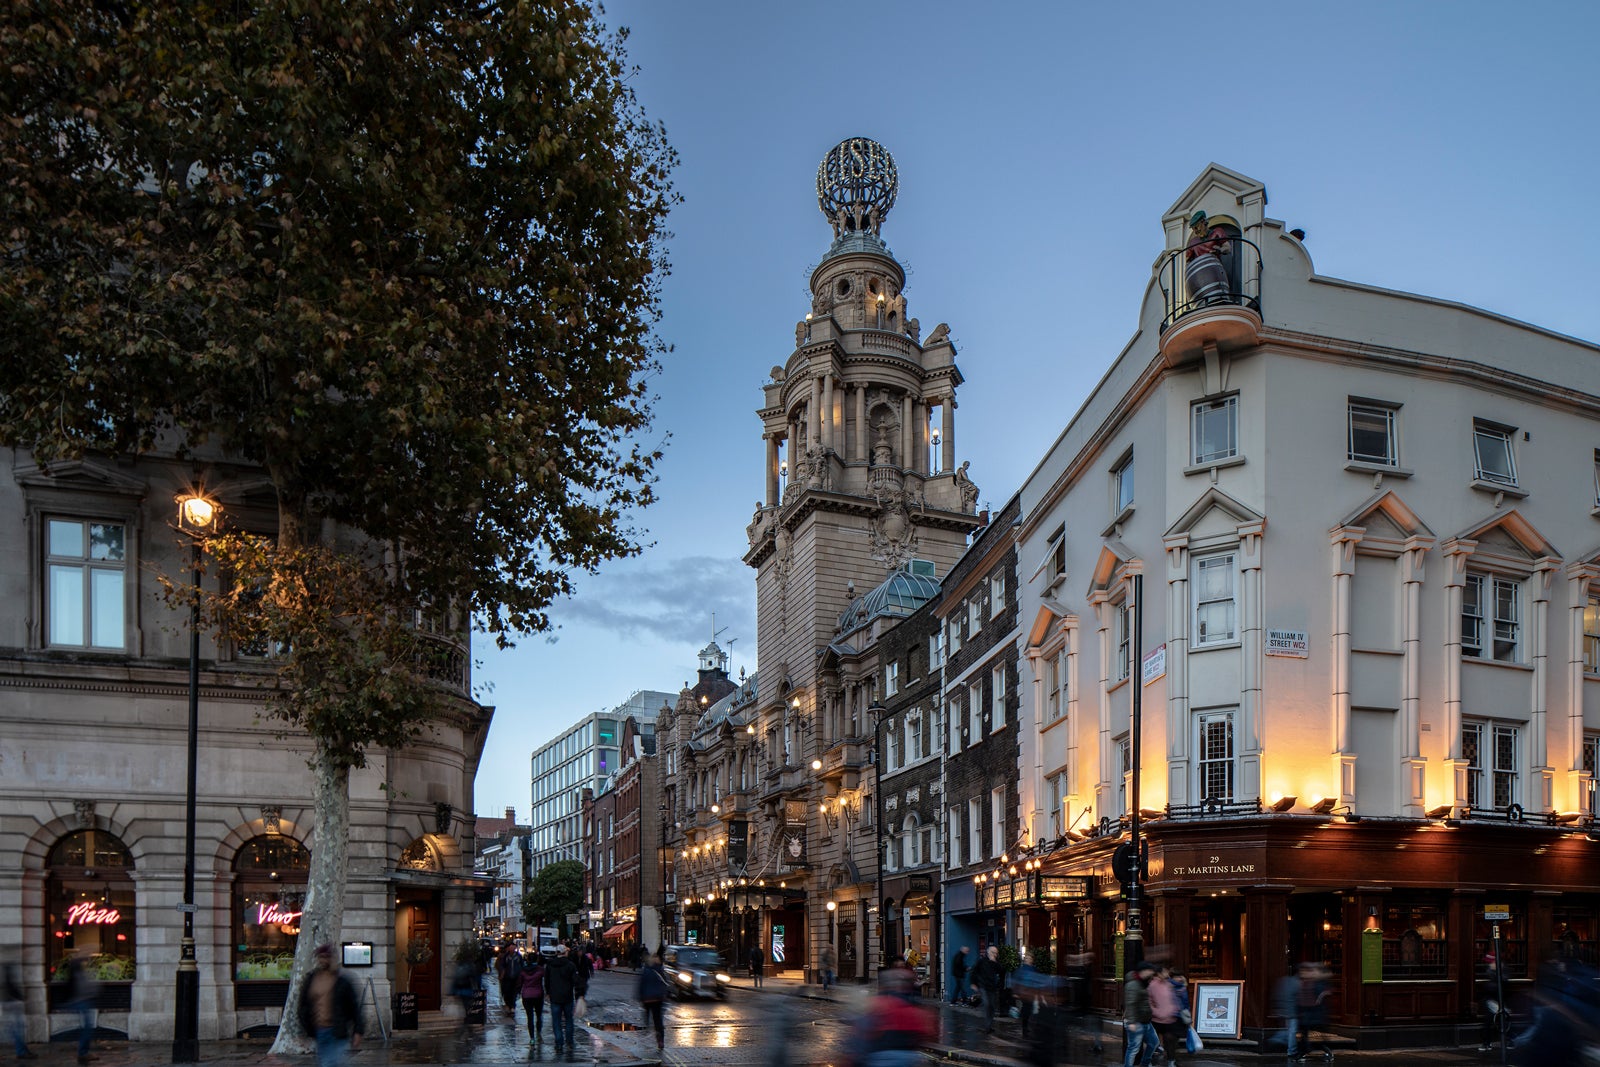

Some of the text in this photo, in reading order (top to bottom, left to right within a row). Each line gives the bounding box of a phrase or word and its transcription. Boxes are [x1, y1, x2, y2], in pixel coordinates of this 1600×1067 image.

[1270, 631, 1304, 641] WILLIAM IV
[1270, 639, 1306, 649] STREET WC2
[1209, 856, 1220, 864] 29
[1173, 864, 1255, 875] ST. MARTINS LANE
[67, 901, 121, 926] Pizza
[258, 902, 303, 926] Vino
